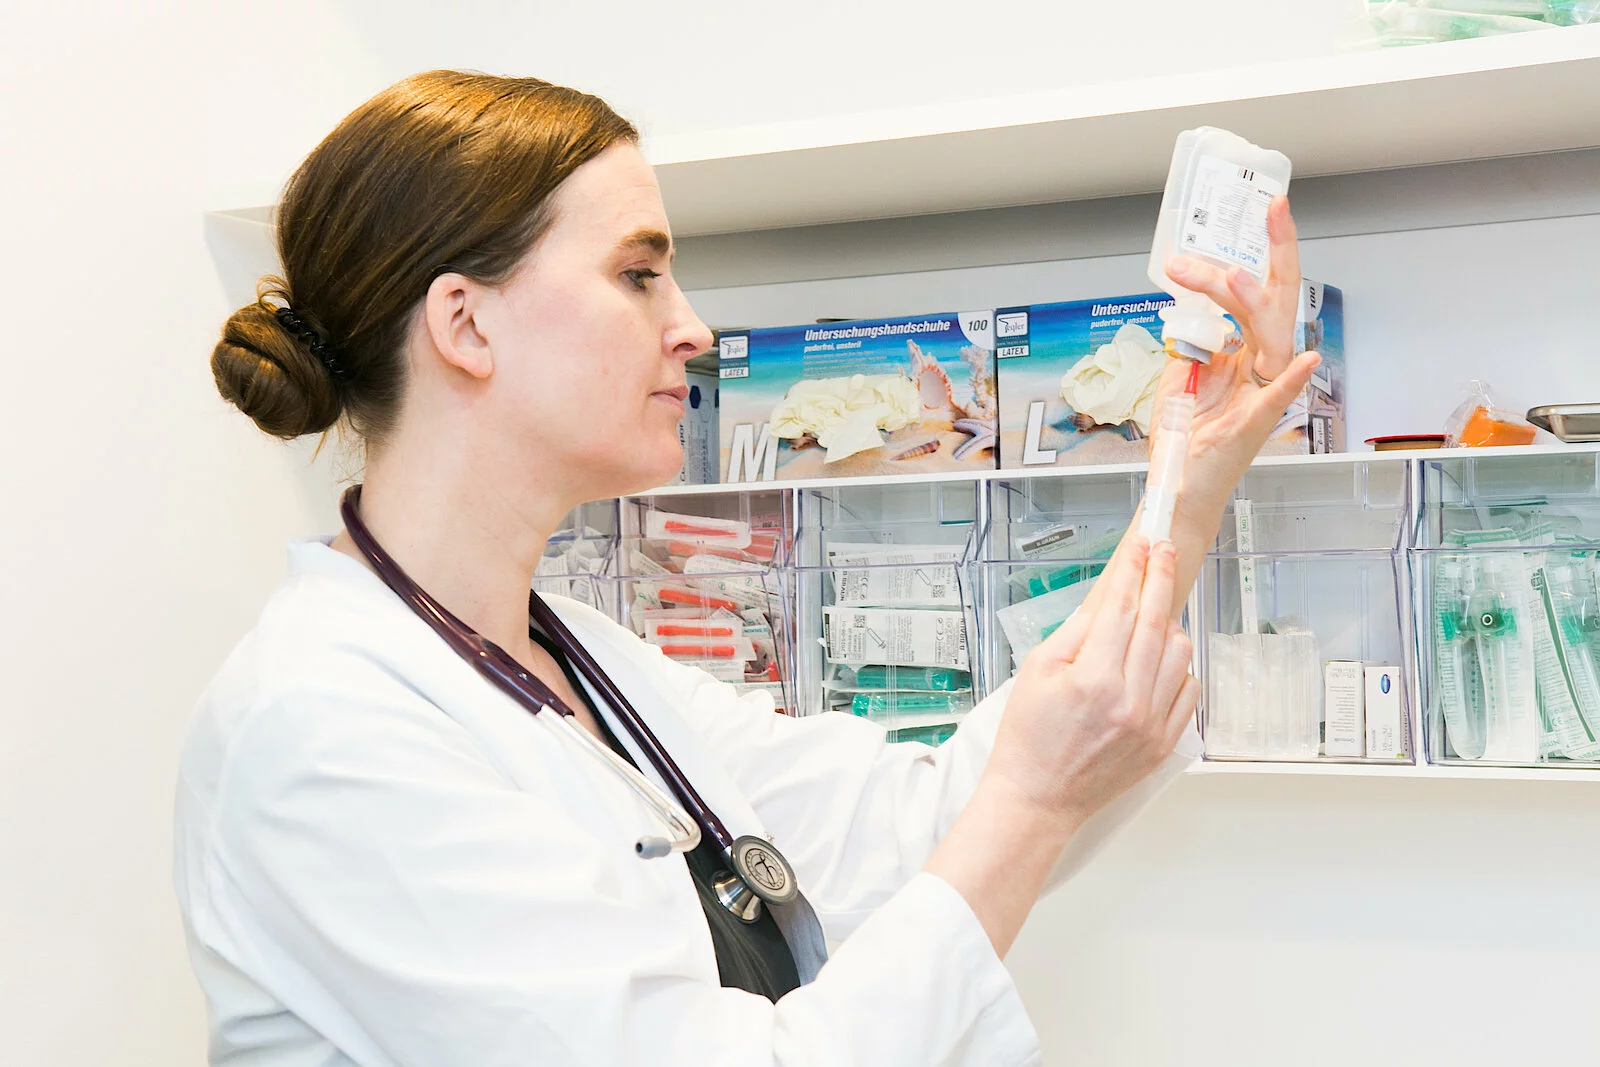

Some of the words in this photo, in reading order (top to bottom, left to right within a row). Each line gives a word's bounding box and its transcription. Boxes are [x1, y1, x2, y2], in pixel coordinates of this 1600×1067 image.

[1309, 286, 1317, 309] 100
[804, 319, 951, 342] Untersuchungshandschuhe
[967, 319, 988, 332] 100
[1002, 346, 1025, 357] LATEX
[724, 369, 745, 377] LATEX
[1023, 401, 1057, 465] L
[727, 422, 780, 483] M
